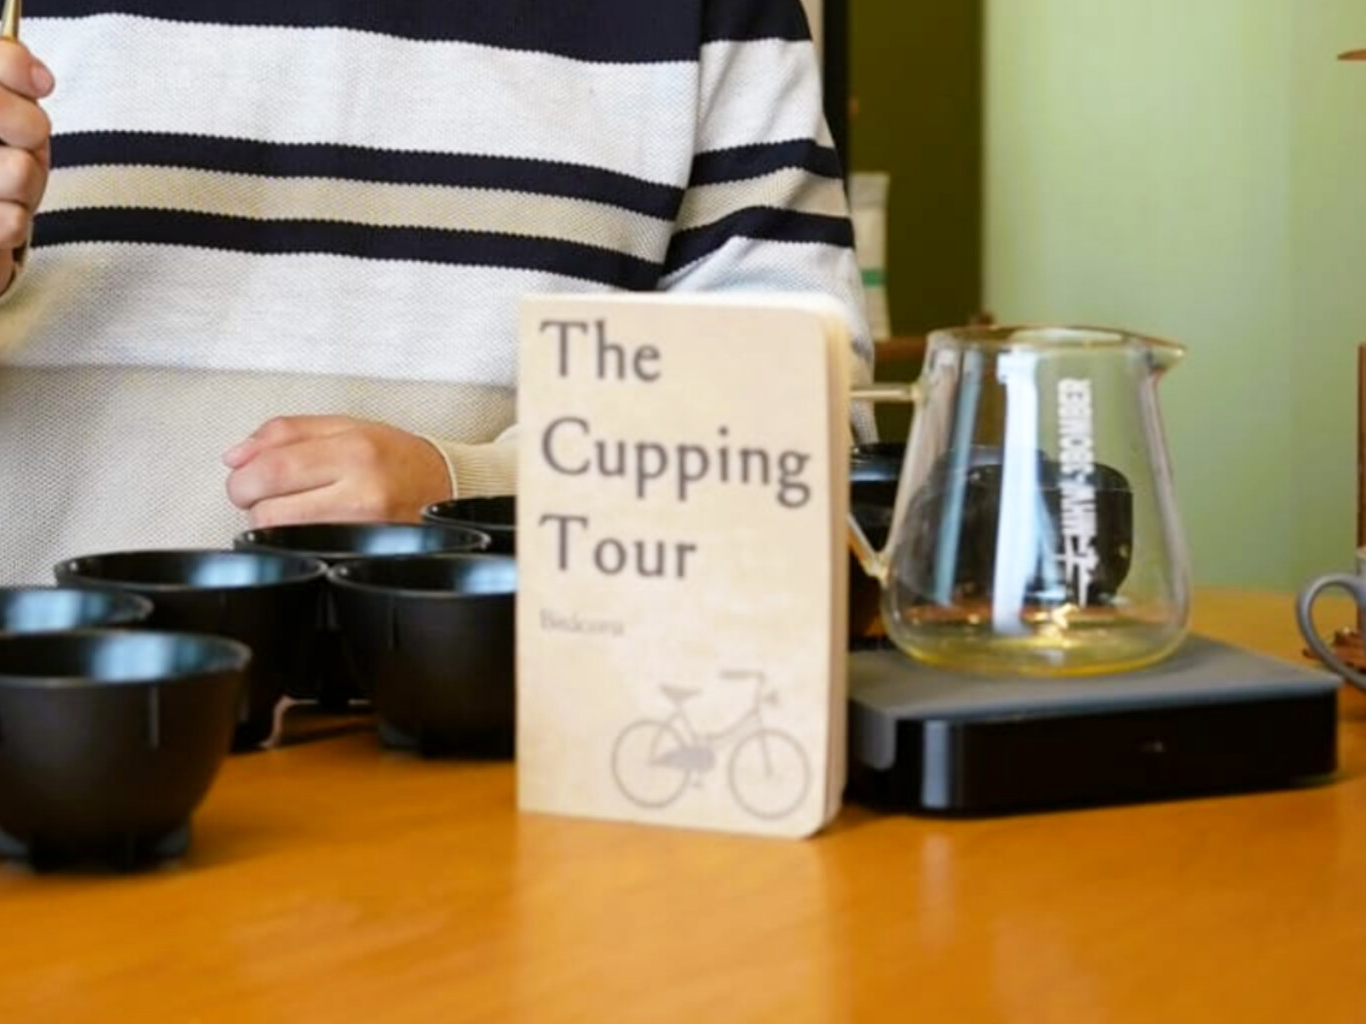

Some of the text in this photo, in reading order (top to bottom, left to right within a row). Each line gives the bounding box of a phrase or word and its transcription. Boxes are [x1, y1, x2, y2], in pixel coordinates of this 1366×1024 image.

[539, 319, 661, 383] The
[540, 416, 812, 509] Cupping
[539, 514, 697, 579] Tour
